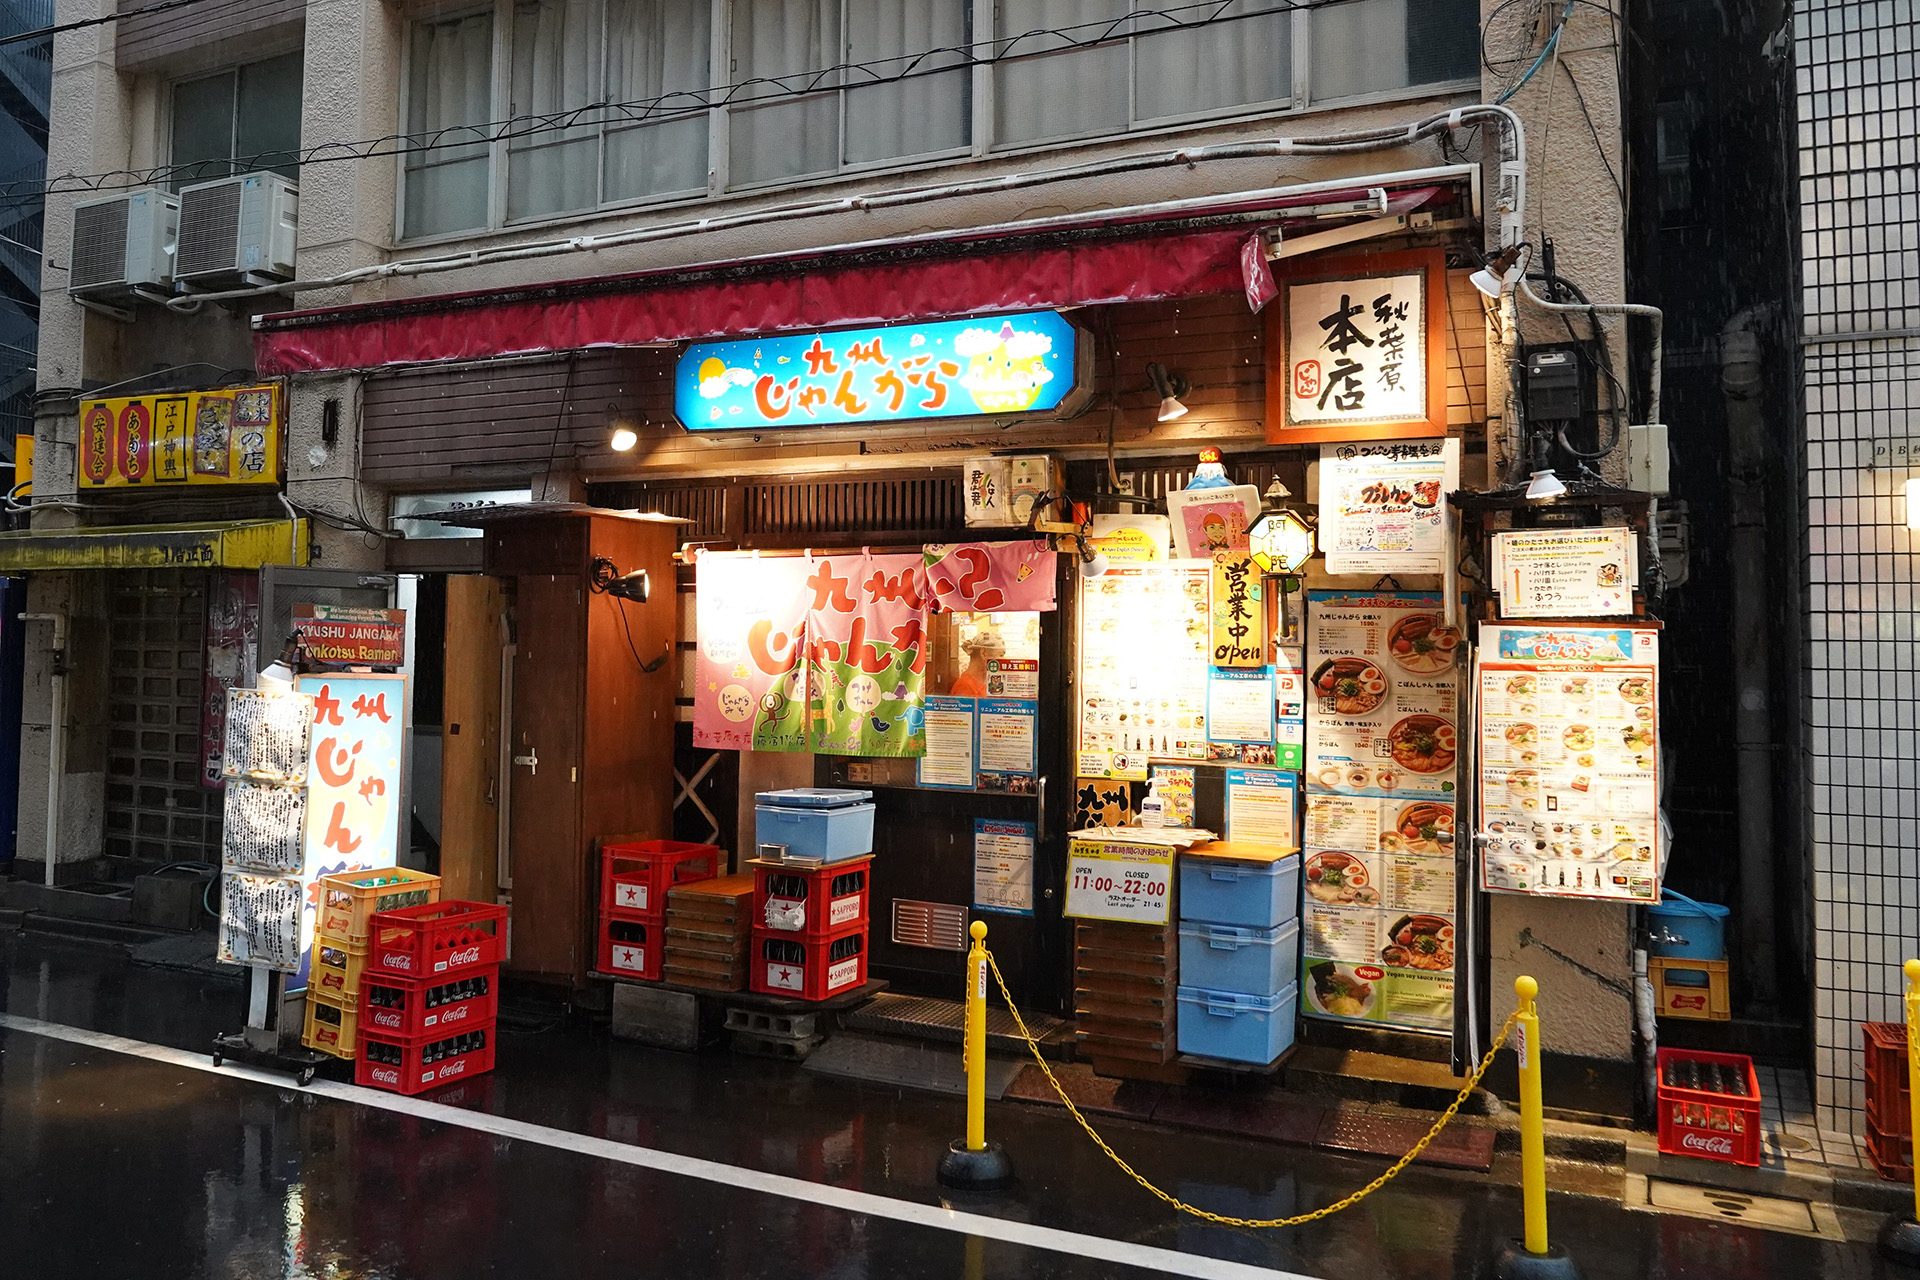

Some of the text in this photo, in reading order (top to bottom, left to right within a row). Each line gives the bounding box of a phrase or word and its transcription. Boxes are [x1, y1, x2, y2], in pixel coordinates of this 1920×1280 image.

[1373, 294, 1409, 392] 秋葉原
[803, 337, 890, 376] 九州
[1317, 294, 1374, 411] 本店
[1298, 363, 1317, 394] じゃん
[754, 355, 959, 420] じゃんがら
[164, 403, 178, 476] 江戸神輿
[240, 432, 265, 472] の店
[1268, 520, 1288, 571] 阿陀
[806, 560, 927, 613] 九州
[1225, 558, 1252, 647] 営業中
[1535, 592, 1562, 602] ふつう
[298, 625, 399, 641] KYUSHU JANGARA
[1546, 633, 1577, 645] 九州
[359, 645, 399, 661] Ramen
[1534, 645, 1594, 659] じゃんがら
[314, 684, 392, 726] 九州
[1077, 784, 1129, 812] 九州
[1103, 845, 1169, 858] 営業時間のお知らせ
[1125, 871, 1149, 879] CLOSED
[836, 901, 858, 916] SAPPORO
[383, 953, 413, 970] Coca-Cola
[449, 946, 480, 967] Coca-Cola
[834, 964, 857, 980] SAPPORO
[1359, 968, 1380, 977] Vegan
[1386, 970, 1405, 978] Vegan
[374, 1011, 401, 1028] Coca-Cola
[441, 1006, 468, 1023] Coca-Cola
[372, 1067, 399, 1084] Coca-Cola
[439, 1060, 466, 1078] Coca-Cola
[1682, 1133, 1733, 1155] Coca-Cola
